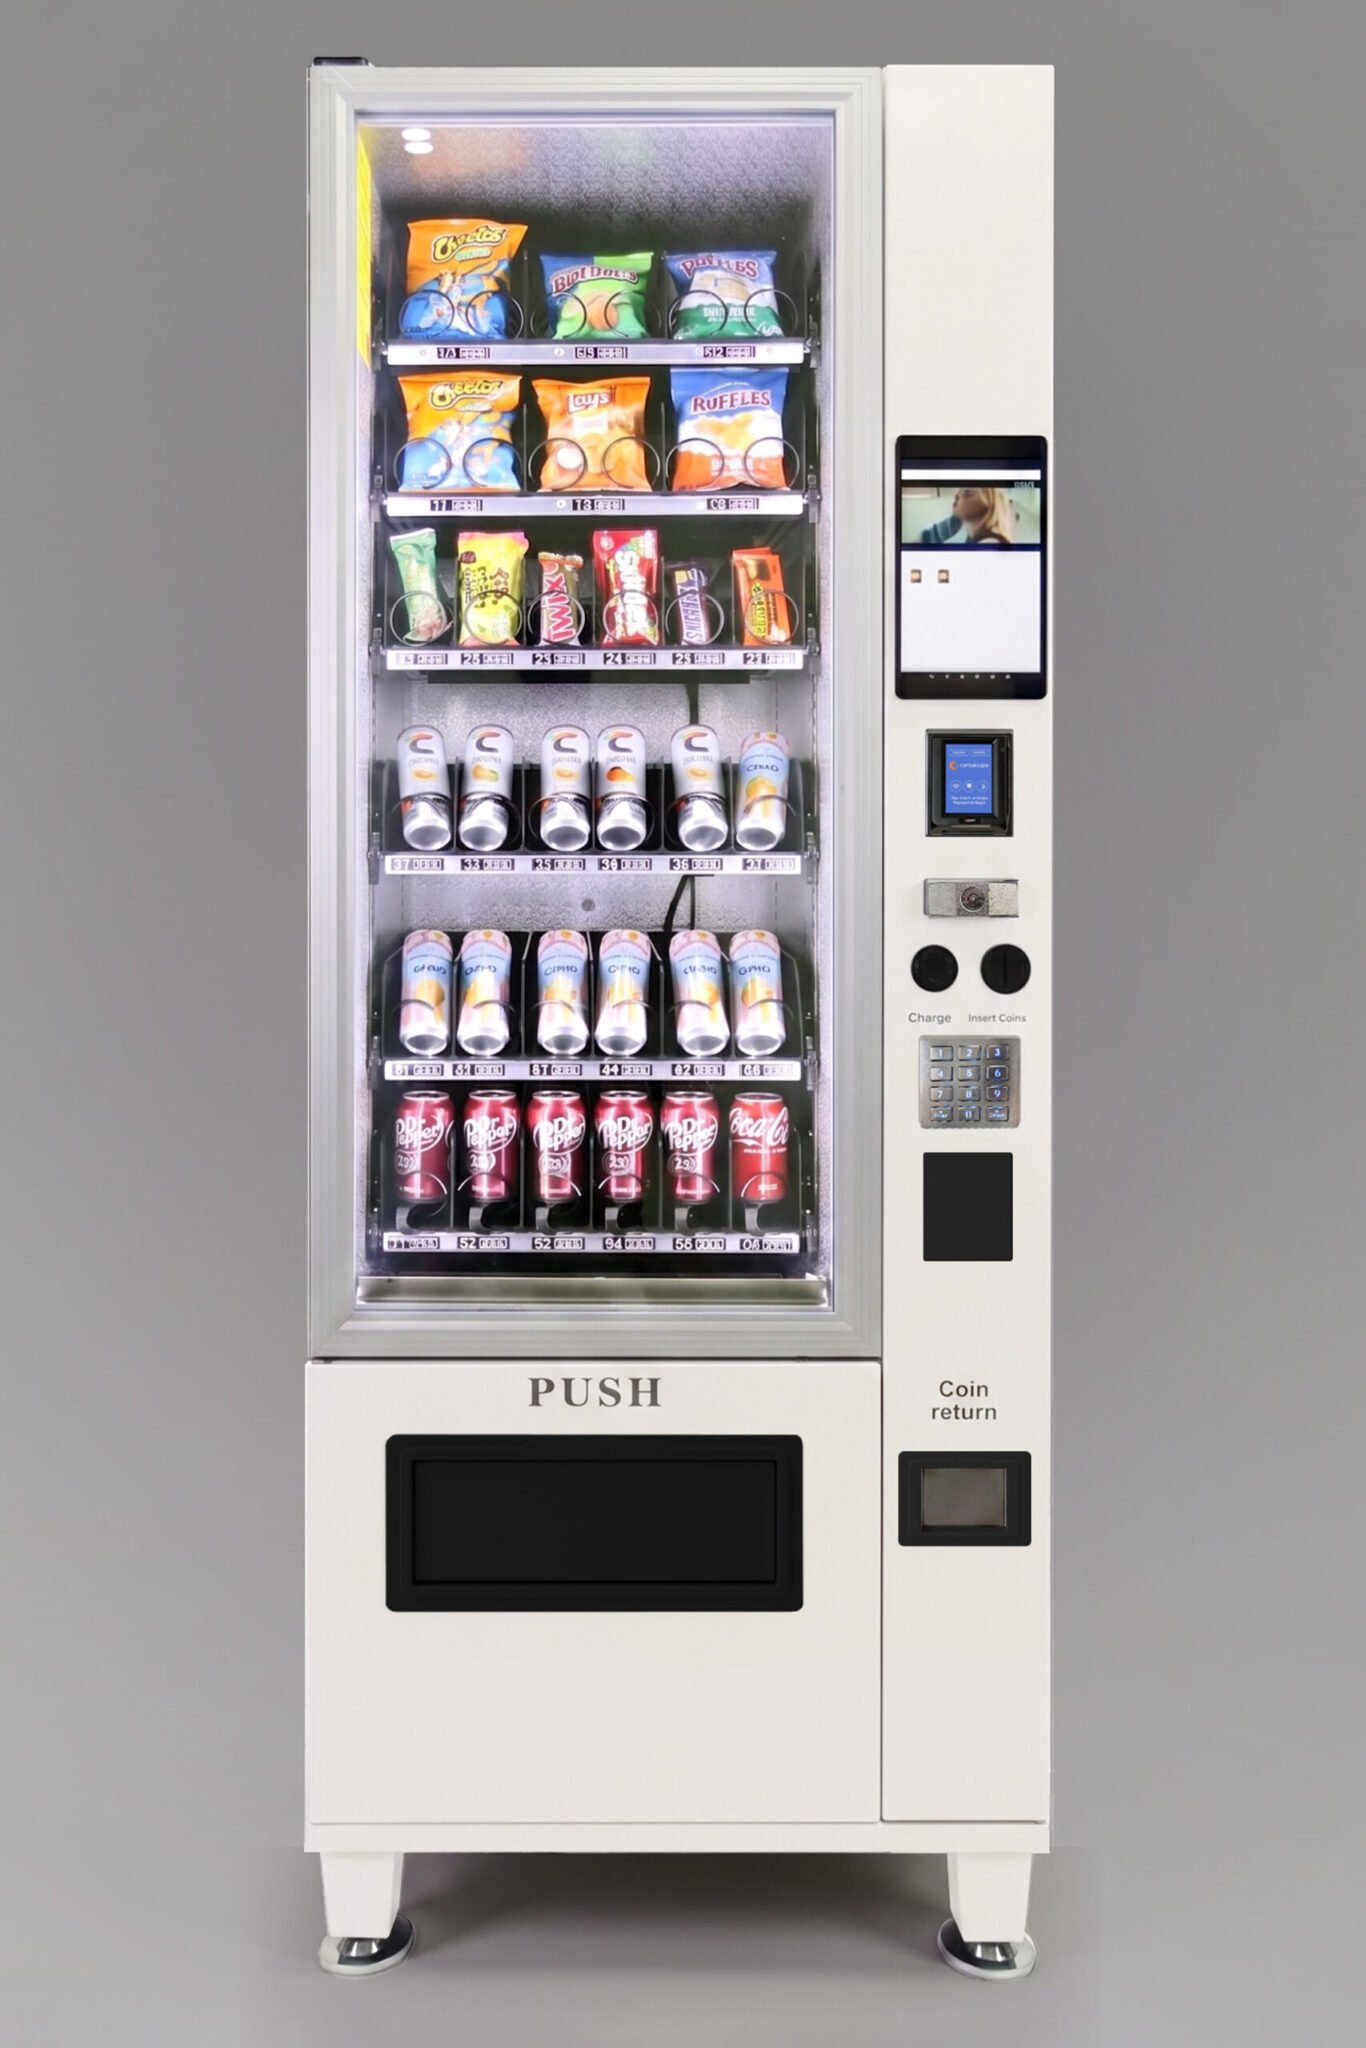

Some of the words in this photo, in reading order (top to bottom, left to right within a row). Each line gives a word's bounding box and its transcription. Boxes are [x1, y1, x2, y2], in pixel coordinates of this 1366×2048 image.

[692, 390, 770, 412] RUFFLES
[908, 1012, 952, 1025] Charge
[968, 1013, 996, 1023] Insert
[998, 1013, 1027, 1023] Coins
[966, 1048, 973, 1057] 2
[993, 1048, 1001, 1057] 3
[937, 1070, 944, 1079] 4
[966, 1070, 973, 1079] 5
[994, 1069, 1001, 1078] 6
[937, 1090, 944, 1098] 7
[993, 1089, 1001, 1098] 9
[528, 1377, 662, 1407] PUSH
[939, 1380, 989, 1398] Coin
[932, 1404, 997, 1421] return
